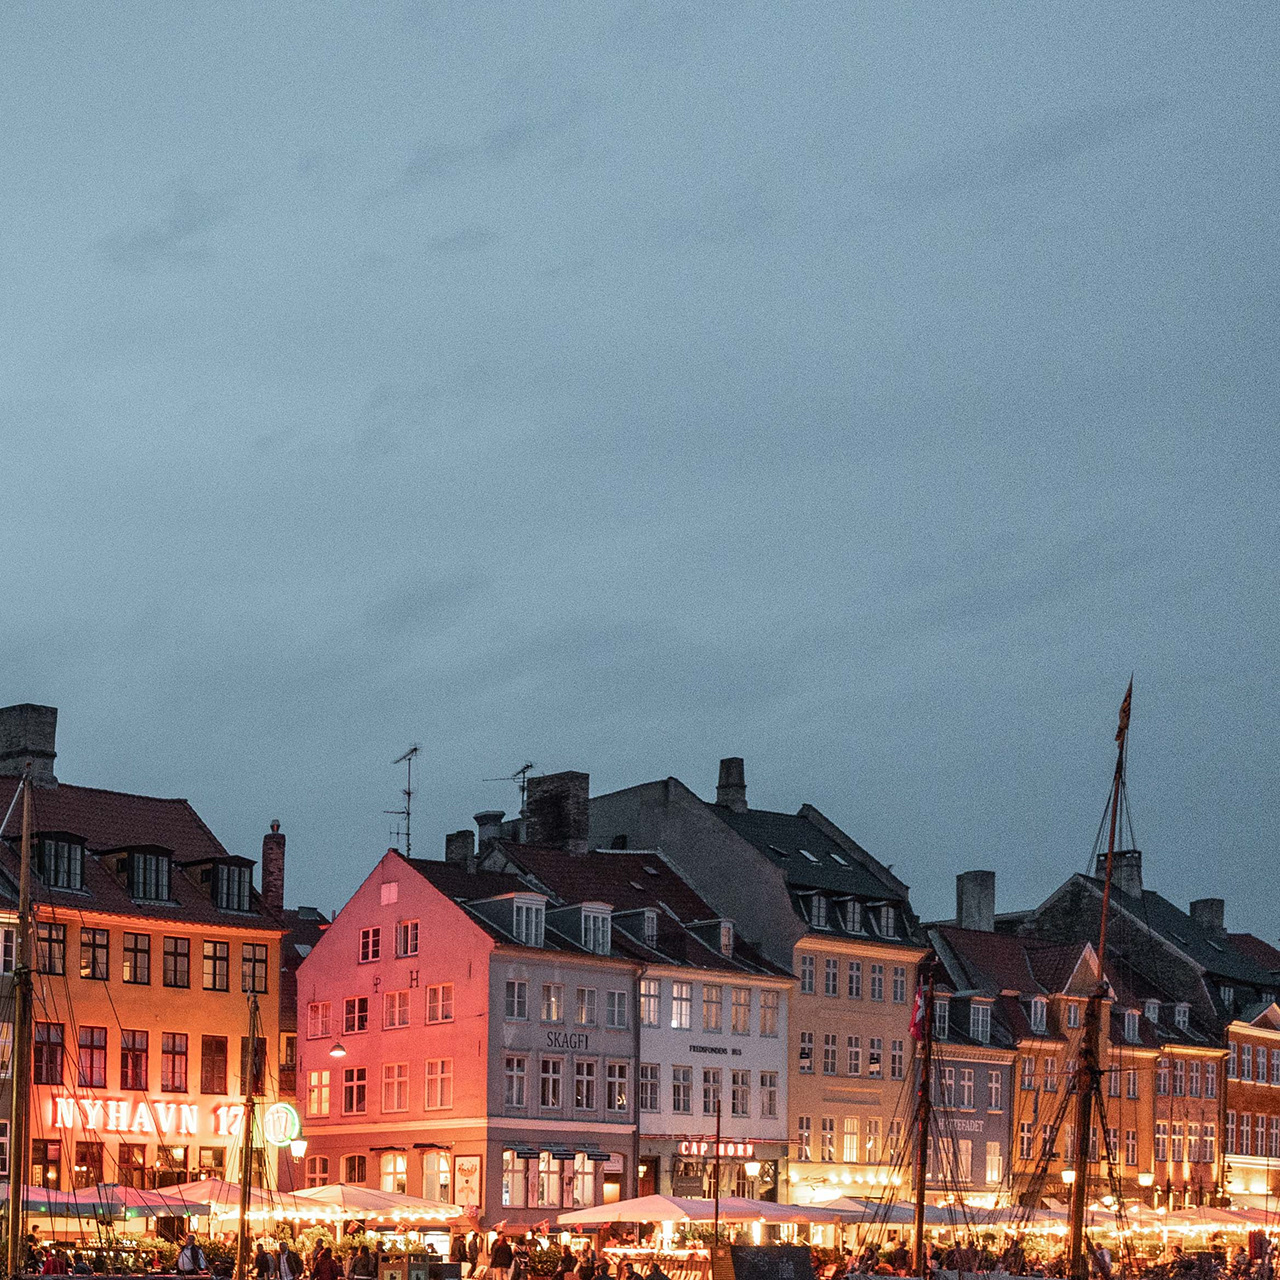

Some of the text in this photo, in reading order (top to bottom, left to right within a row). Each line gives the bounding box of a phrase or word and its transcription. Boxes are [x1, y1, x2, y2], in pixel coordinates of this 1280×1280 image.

[55, 1097, 245, 1135] NYHAVN 17
[681, 1141, 708, 1155] CAP
